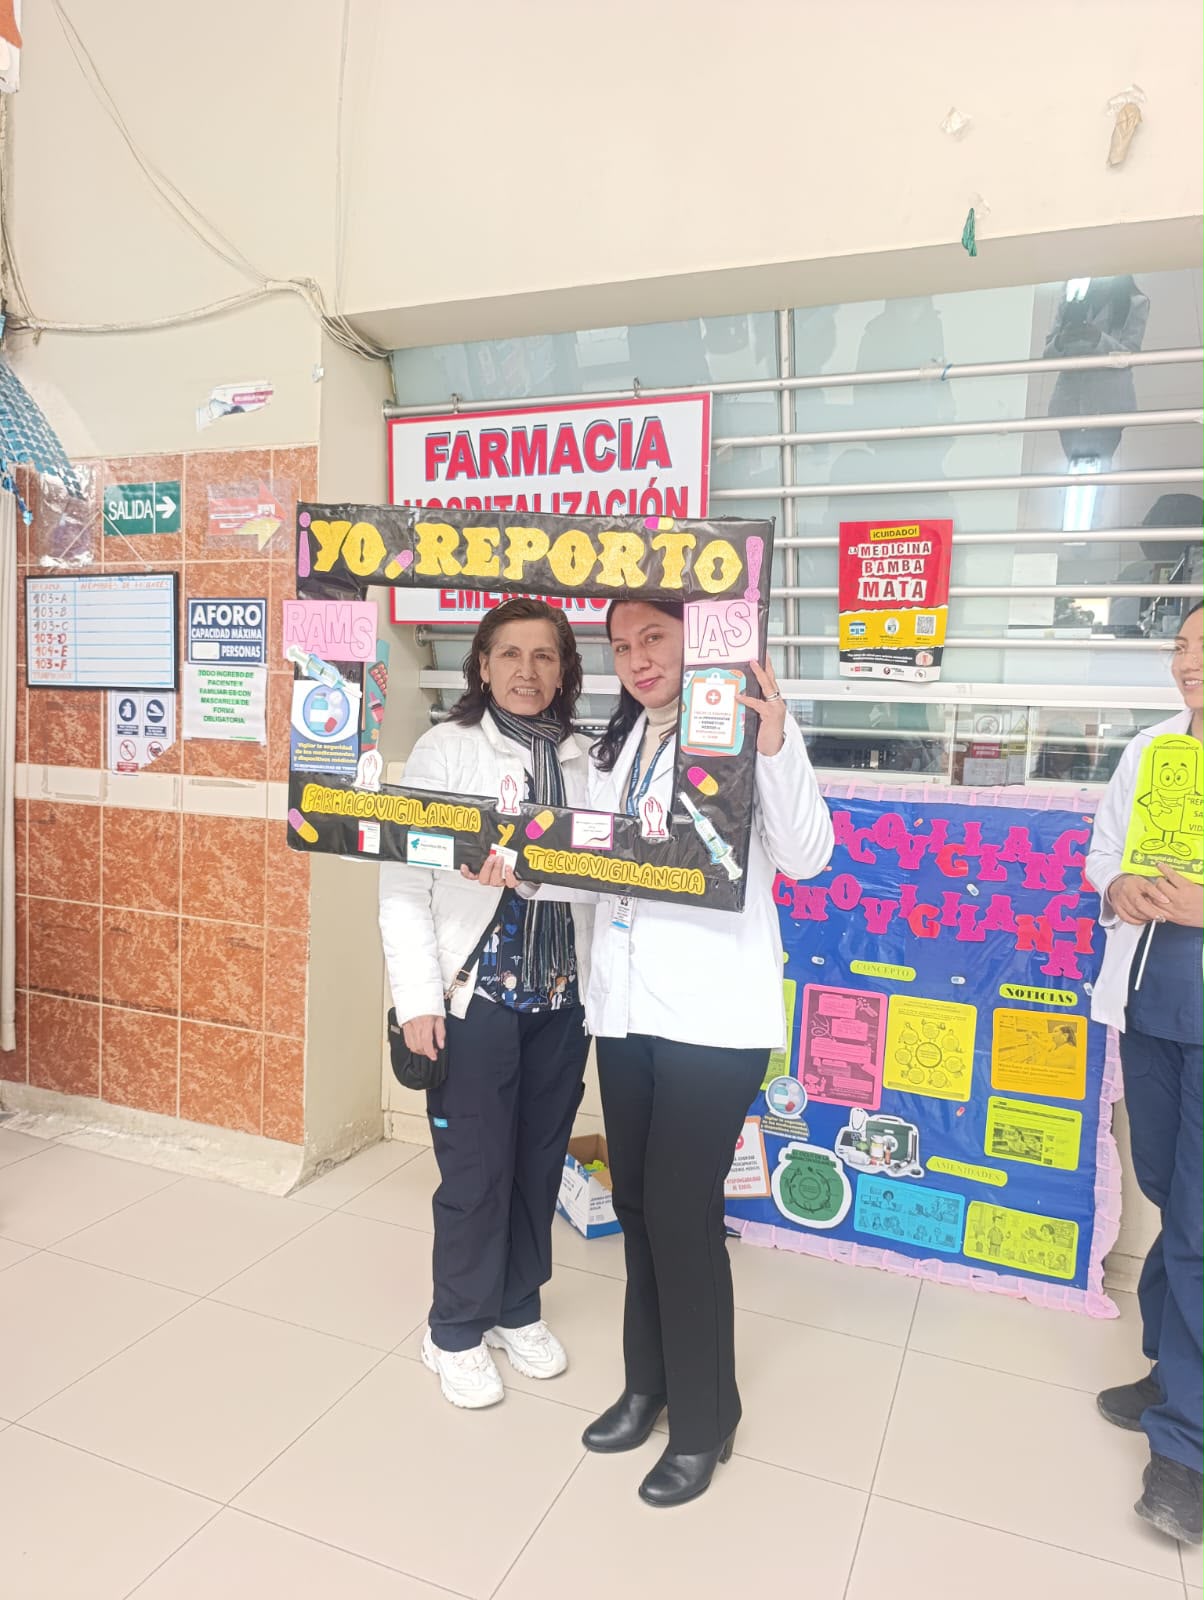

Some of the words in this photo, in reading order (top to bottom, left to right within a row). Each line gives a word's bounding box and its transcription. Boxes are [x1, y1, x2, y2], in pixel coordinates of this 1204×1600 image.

[424, 416, 672, 482] FARMACIA
[108, 499, 153, 521] SALIDA
[872, 528, 917, 539] ¡CUIDADO!
[860, 543, 930, 557] MEDICINA
[415, 522, 764, 600] REPORTO!
[864, 560, 923, 573] BAMBA
[863, 580, 926, 598] MATA
[33, 594, 68, 604] 103-A
[33, 607, 67, 618] 103-B
[192, 604, 262, 626] AFORO
[33, 620, 69, 631] 103-C
[191, 628, 230, 639] CAPACIDAD
[231, 627, 262, 640] MÁXIMA
[286, 603, 374, 659] RAMS
[688, 602, 752, 658] IAS
[221, 645, 261, 658] PERSONAS
[198, 669, 216, 677] TODO
[217, 670, 245, 678] INGRESO
[301, 783, 482, 833] FARMACOVIGILANCIA
[524, 844, 706, 895] TECNOVIGILANCIA
[856, 962, 914, 978] CONCEPTO
[1006, 987, 1074, 1005] NOTICIAS
[935, 1161, 1002, 1183] AMENIDADES
